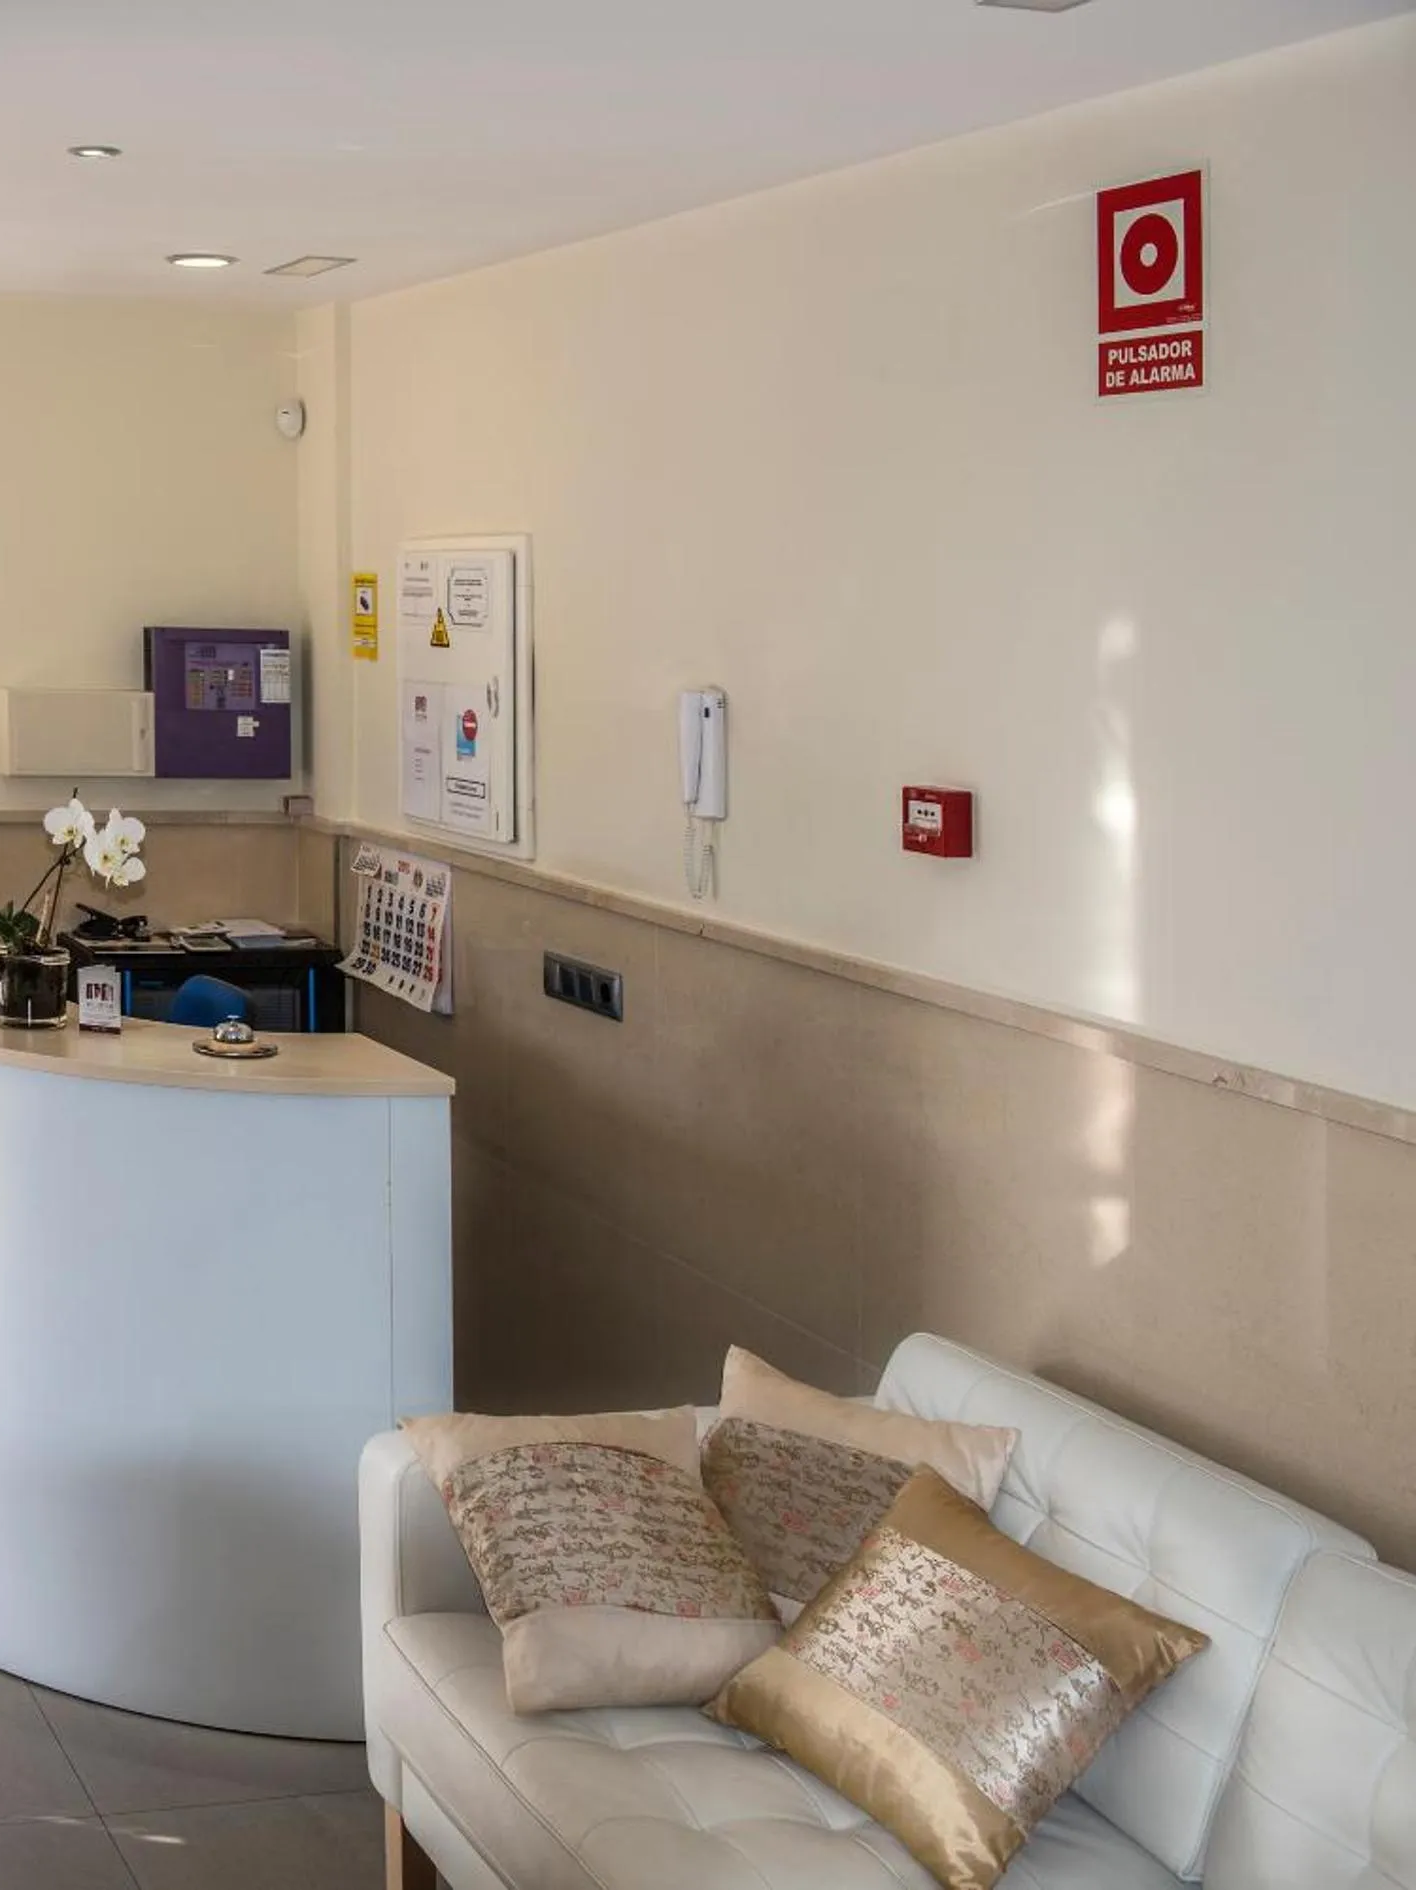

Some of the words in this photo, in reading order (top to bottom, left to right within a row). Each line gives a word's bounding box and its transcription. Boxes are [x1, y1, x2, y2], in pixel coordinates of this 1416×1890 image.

[1109, 340, 1193, 366] PULSADOR
[1105, 370, 1125, 388] DE
[1129, 362, 1195, 386] ALARMA
